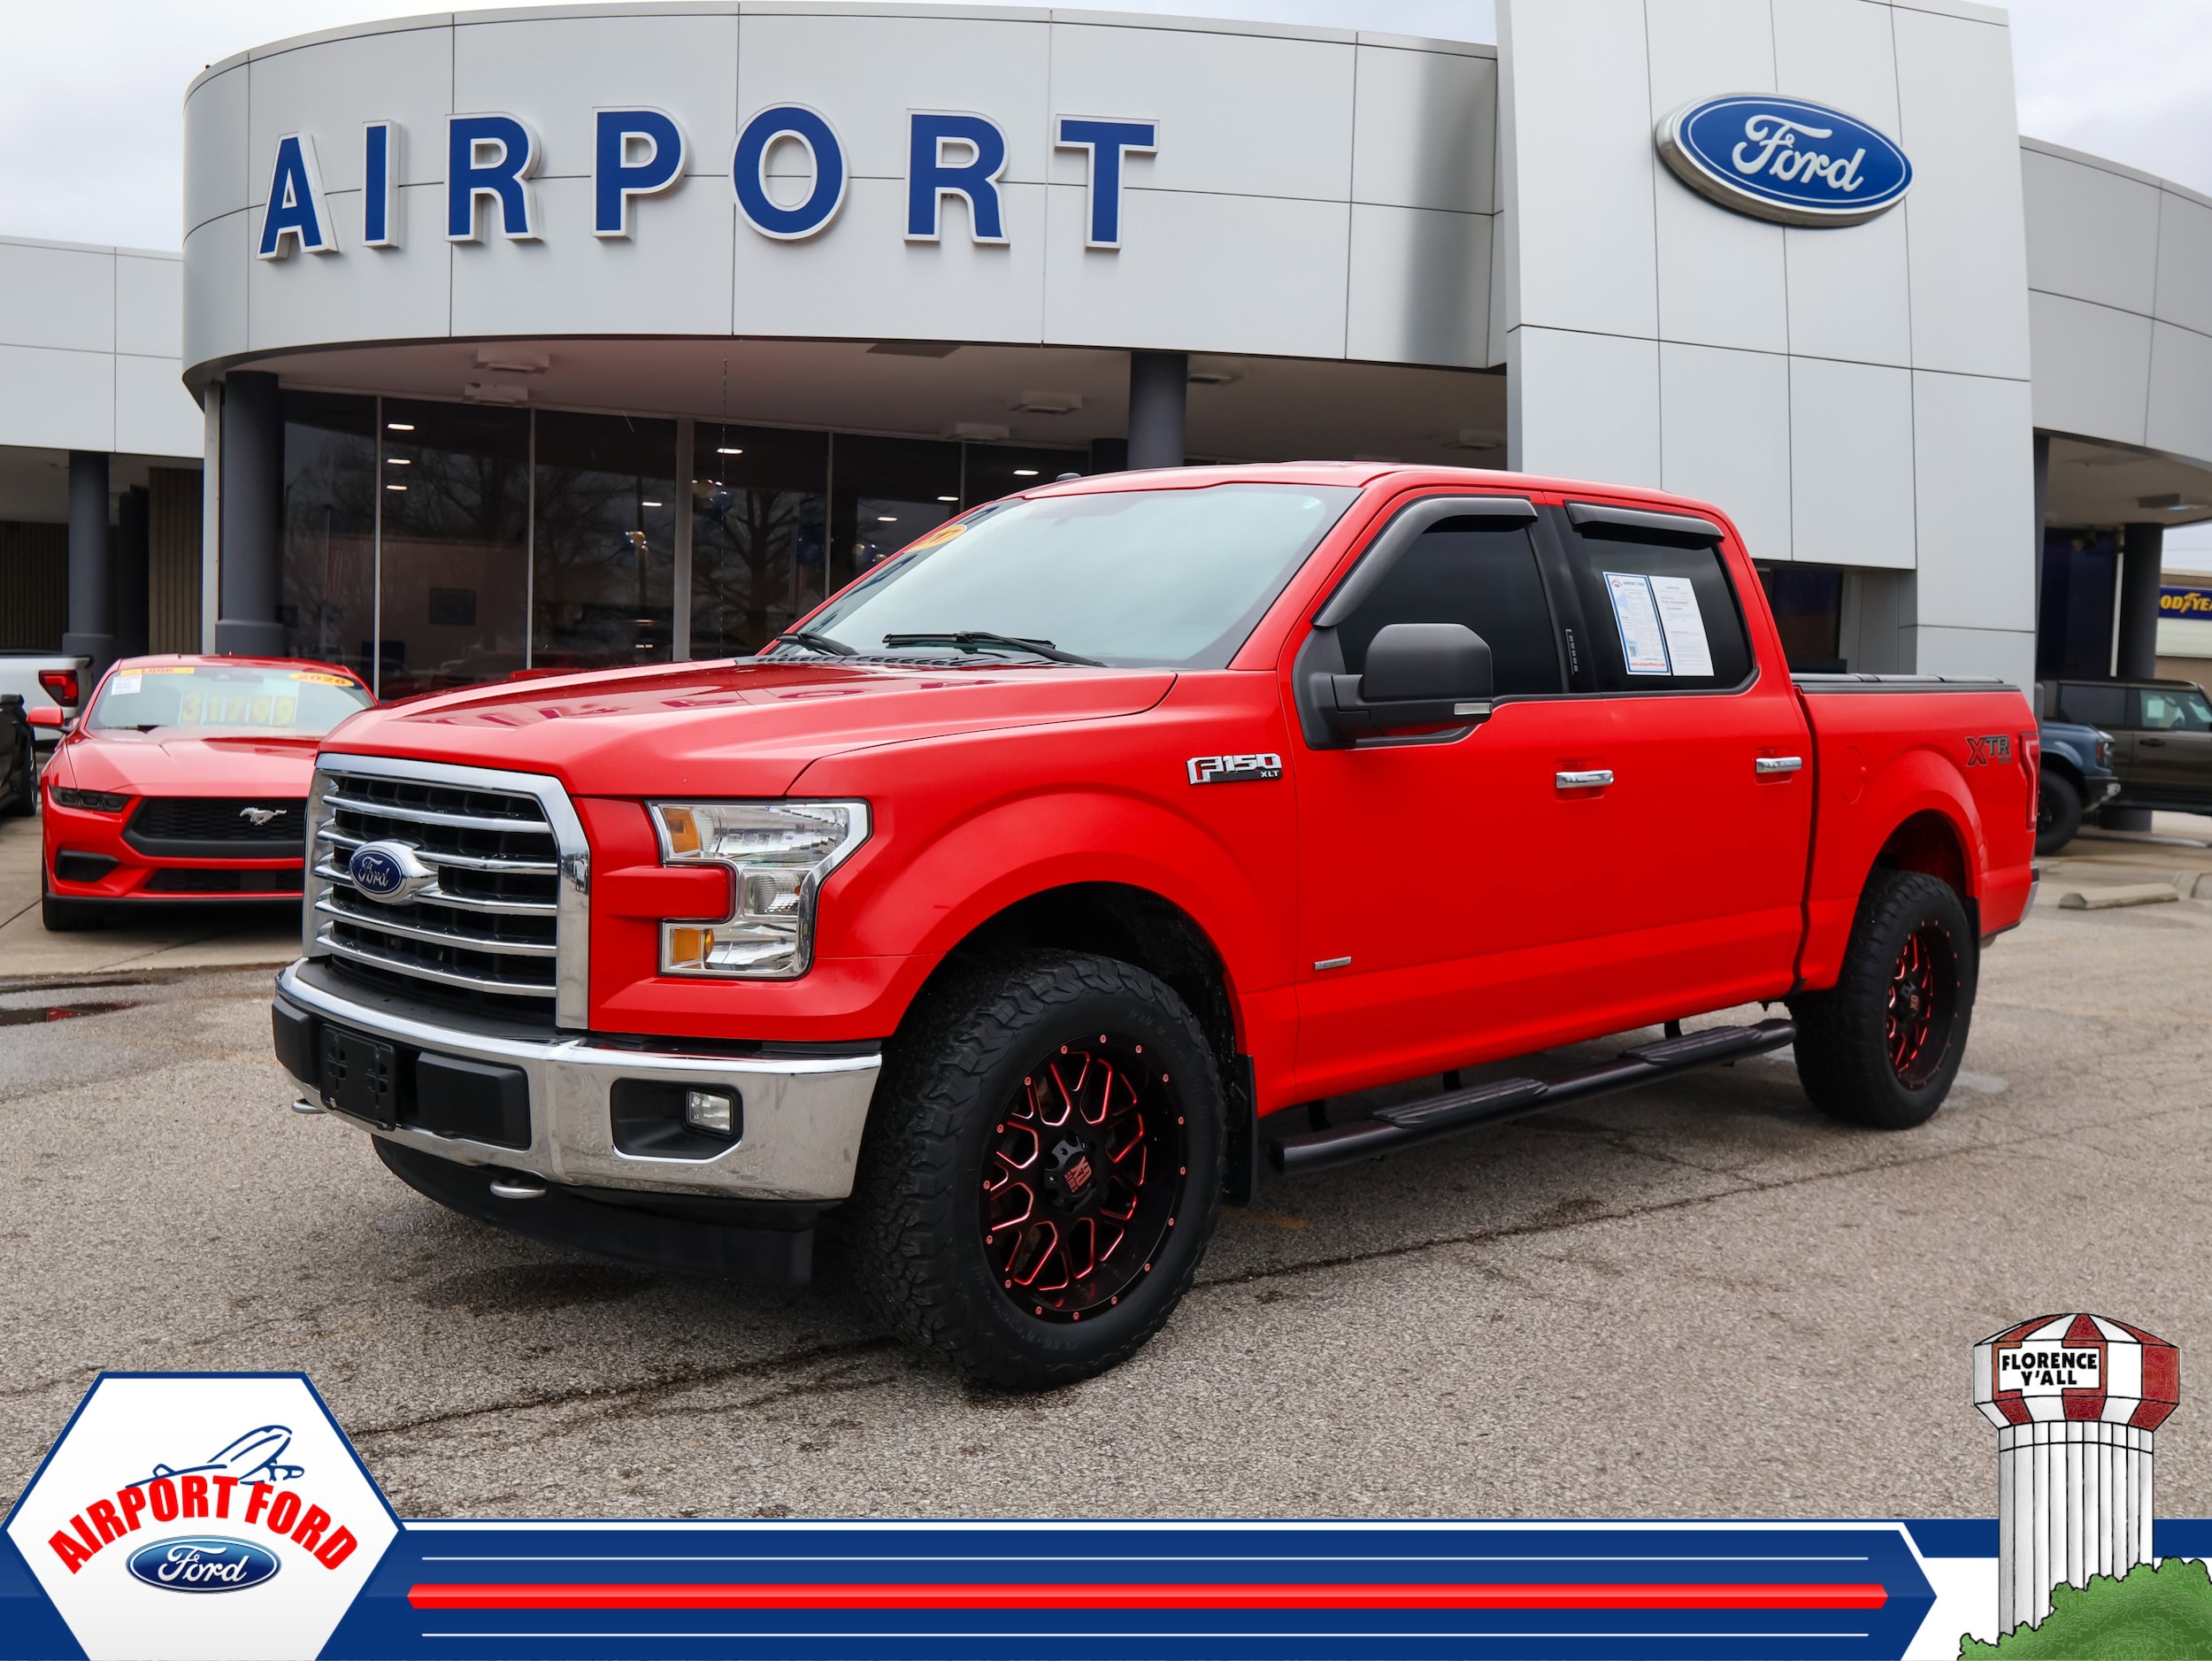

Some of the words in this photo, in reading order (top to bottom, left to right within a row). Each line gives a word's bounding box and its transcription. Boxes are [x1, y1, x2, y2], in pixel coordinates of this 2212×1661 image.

[1732, 114, 1866, 192] Ford
[257, 103, 1159, 260] AIRPORT
[296, 673, 347, 686] 2026
[1966, 735, 2009, 765] XTR
[358, 857, 390, 887] Ford
